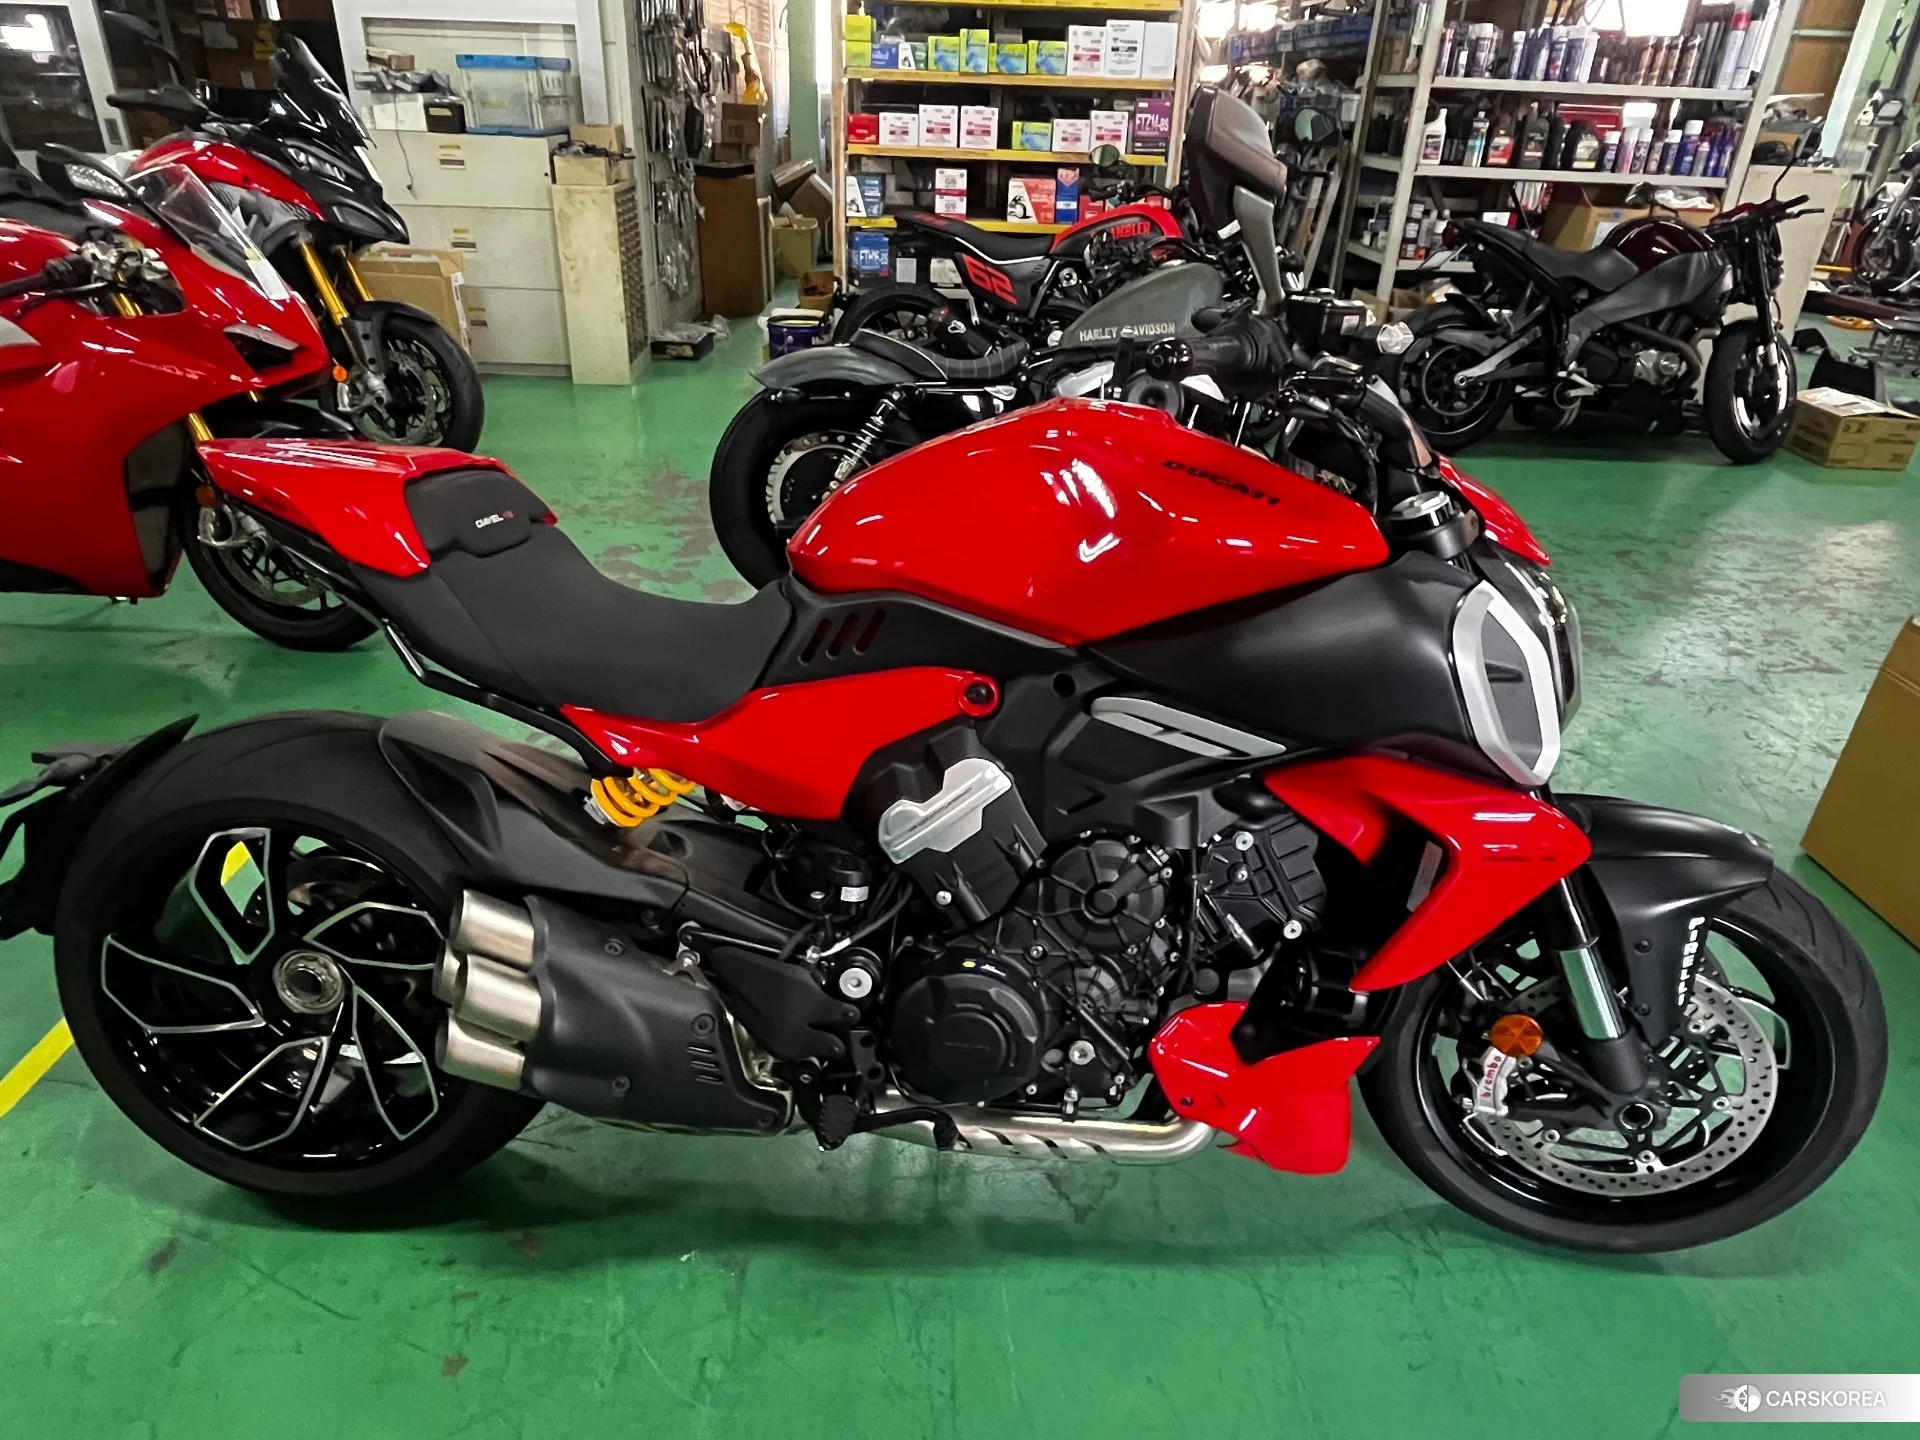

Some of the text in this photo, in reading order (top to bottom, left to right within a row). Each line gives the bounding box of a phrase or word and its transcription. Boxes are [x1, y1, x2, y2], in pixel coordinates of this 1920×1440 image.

[962, 252, 1018, 305] 62
[1130, 322, 1176, 337] AVIDSON
[1163, 460, 1280, 506] DUCATI
[1677, 916, 1706, 1006] PIRELLI
[1481, 1054, 1503, 1098] brembo
